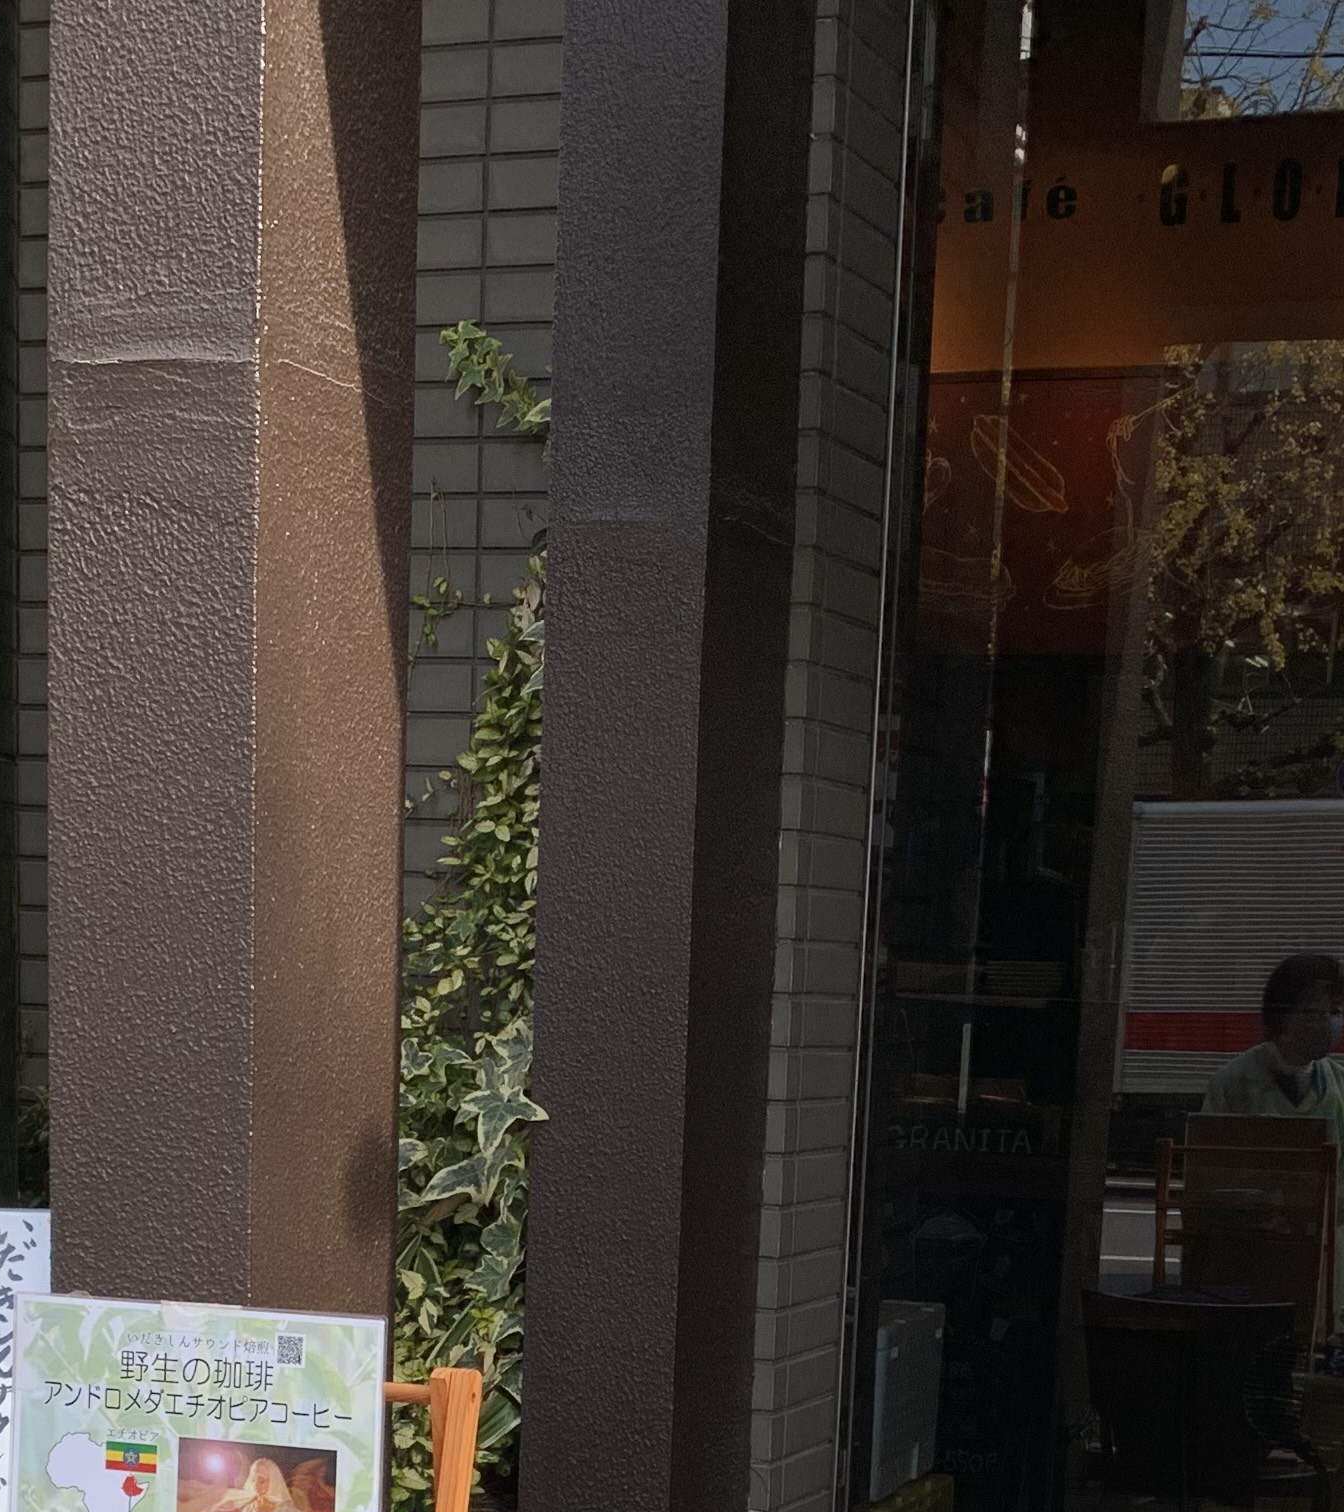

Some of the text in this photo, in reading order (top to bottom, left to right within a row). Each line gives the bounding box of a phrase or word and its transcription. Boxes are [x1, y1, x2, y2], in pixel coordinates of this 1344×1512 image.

[119, 1349, 274, 1392] 野生の珈琲
[43, 1380, 353, 1429] アンドロメダエチオピアコーヒー
[106, 1428, 160, 1441] エチオピア
